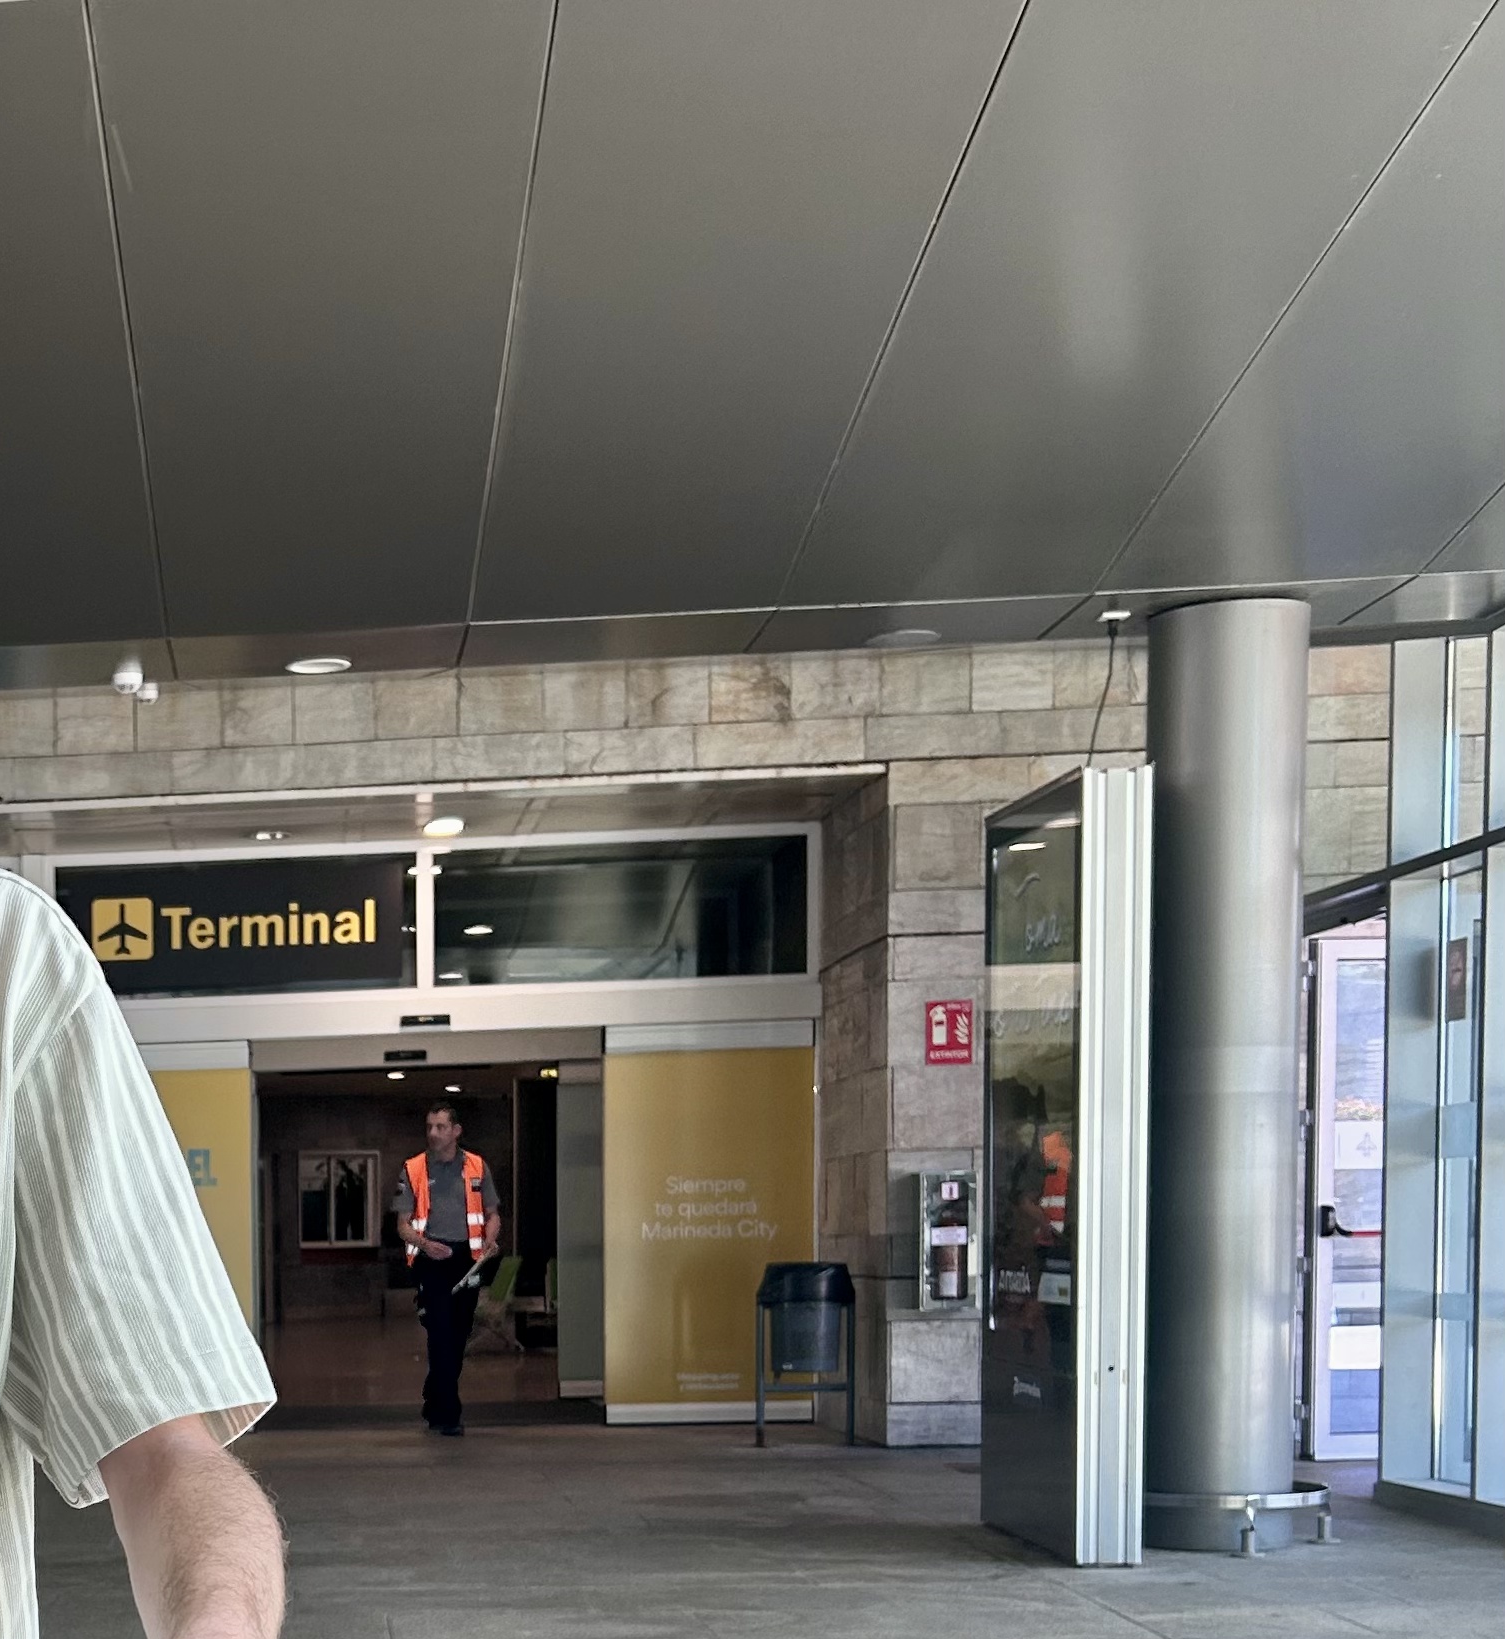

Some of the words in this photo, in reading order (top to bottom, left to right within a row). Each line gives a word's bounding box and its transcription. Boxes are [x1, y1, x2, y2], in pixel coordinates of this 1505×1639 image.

[160, 898, 376, 951] Terminal
[665, 1175, 746, 1196] Siempre
[655, 1201, 673, 1217] te
[641, 1220, 733, 1240] Marineda
[737, 1218, 778, 1241] City
